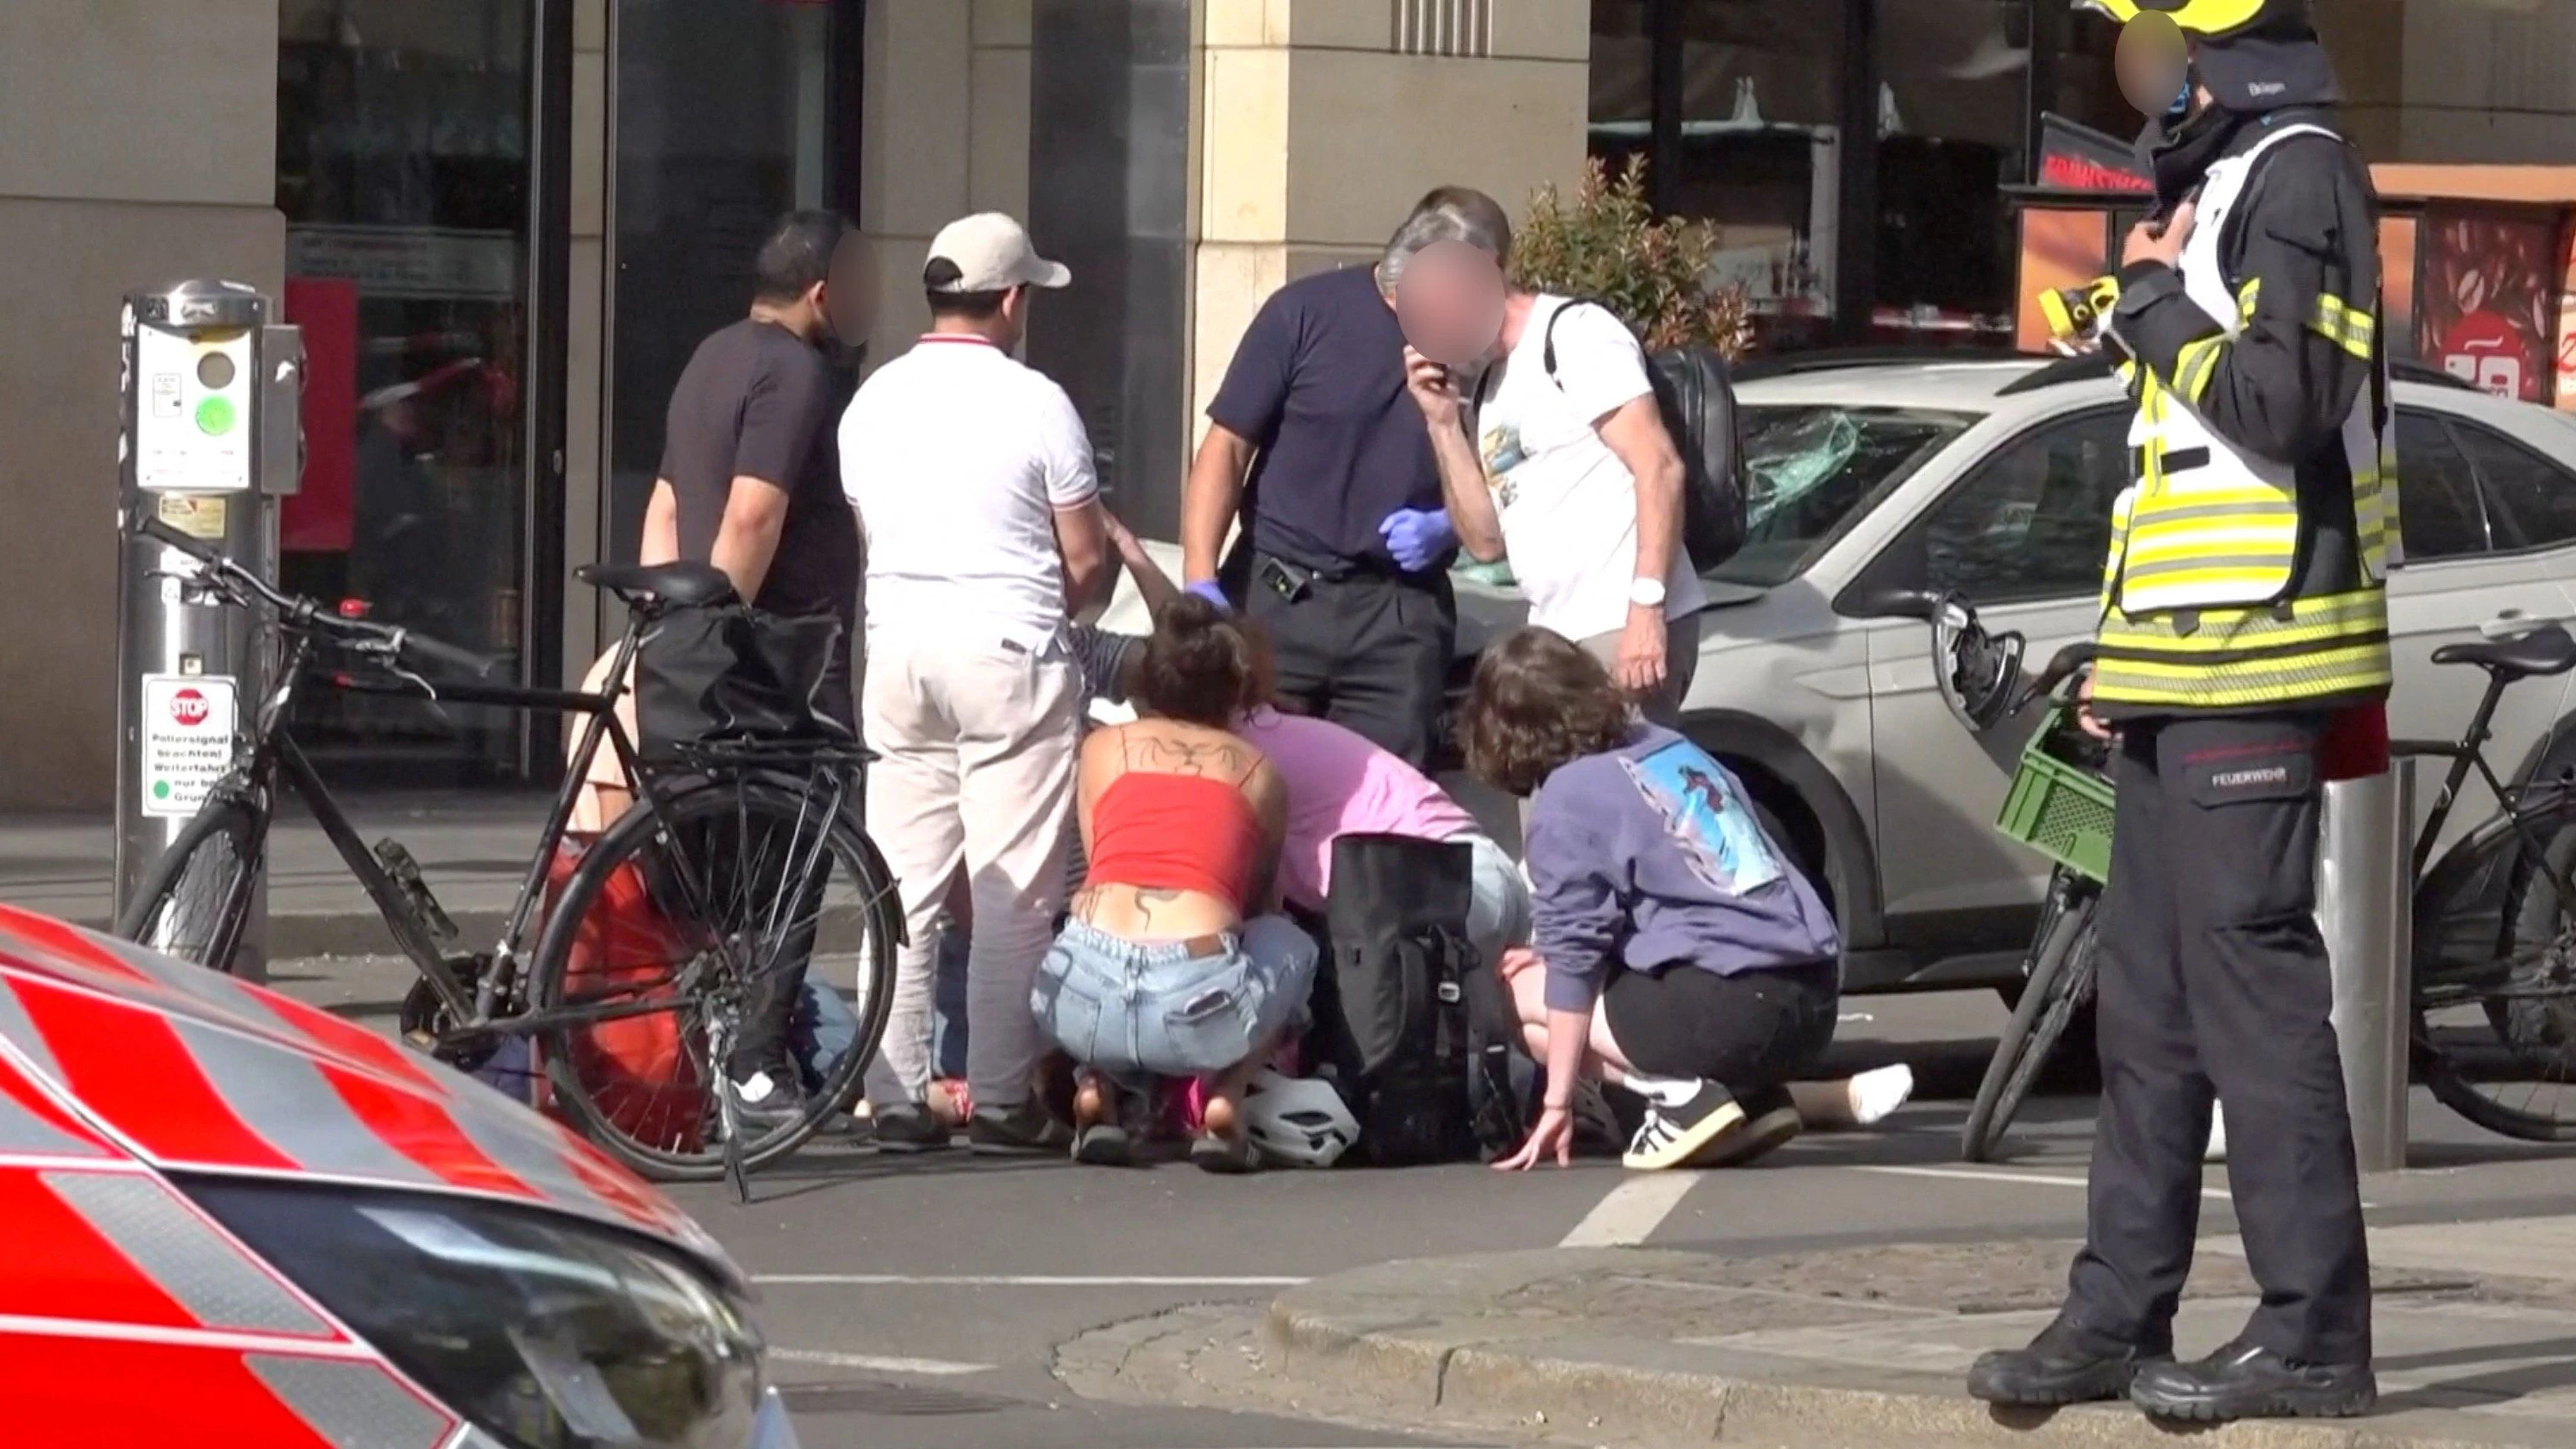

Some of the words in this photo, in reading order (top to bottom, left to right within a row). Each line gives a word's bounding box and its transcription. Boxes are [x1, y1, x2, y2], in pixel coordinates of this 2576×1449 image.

[170, 699, 208, 716] STOP
[152, 734, 228, 746] Pollersignal
[2212, 766, 2287, 788] FEUERWEHR
